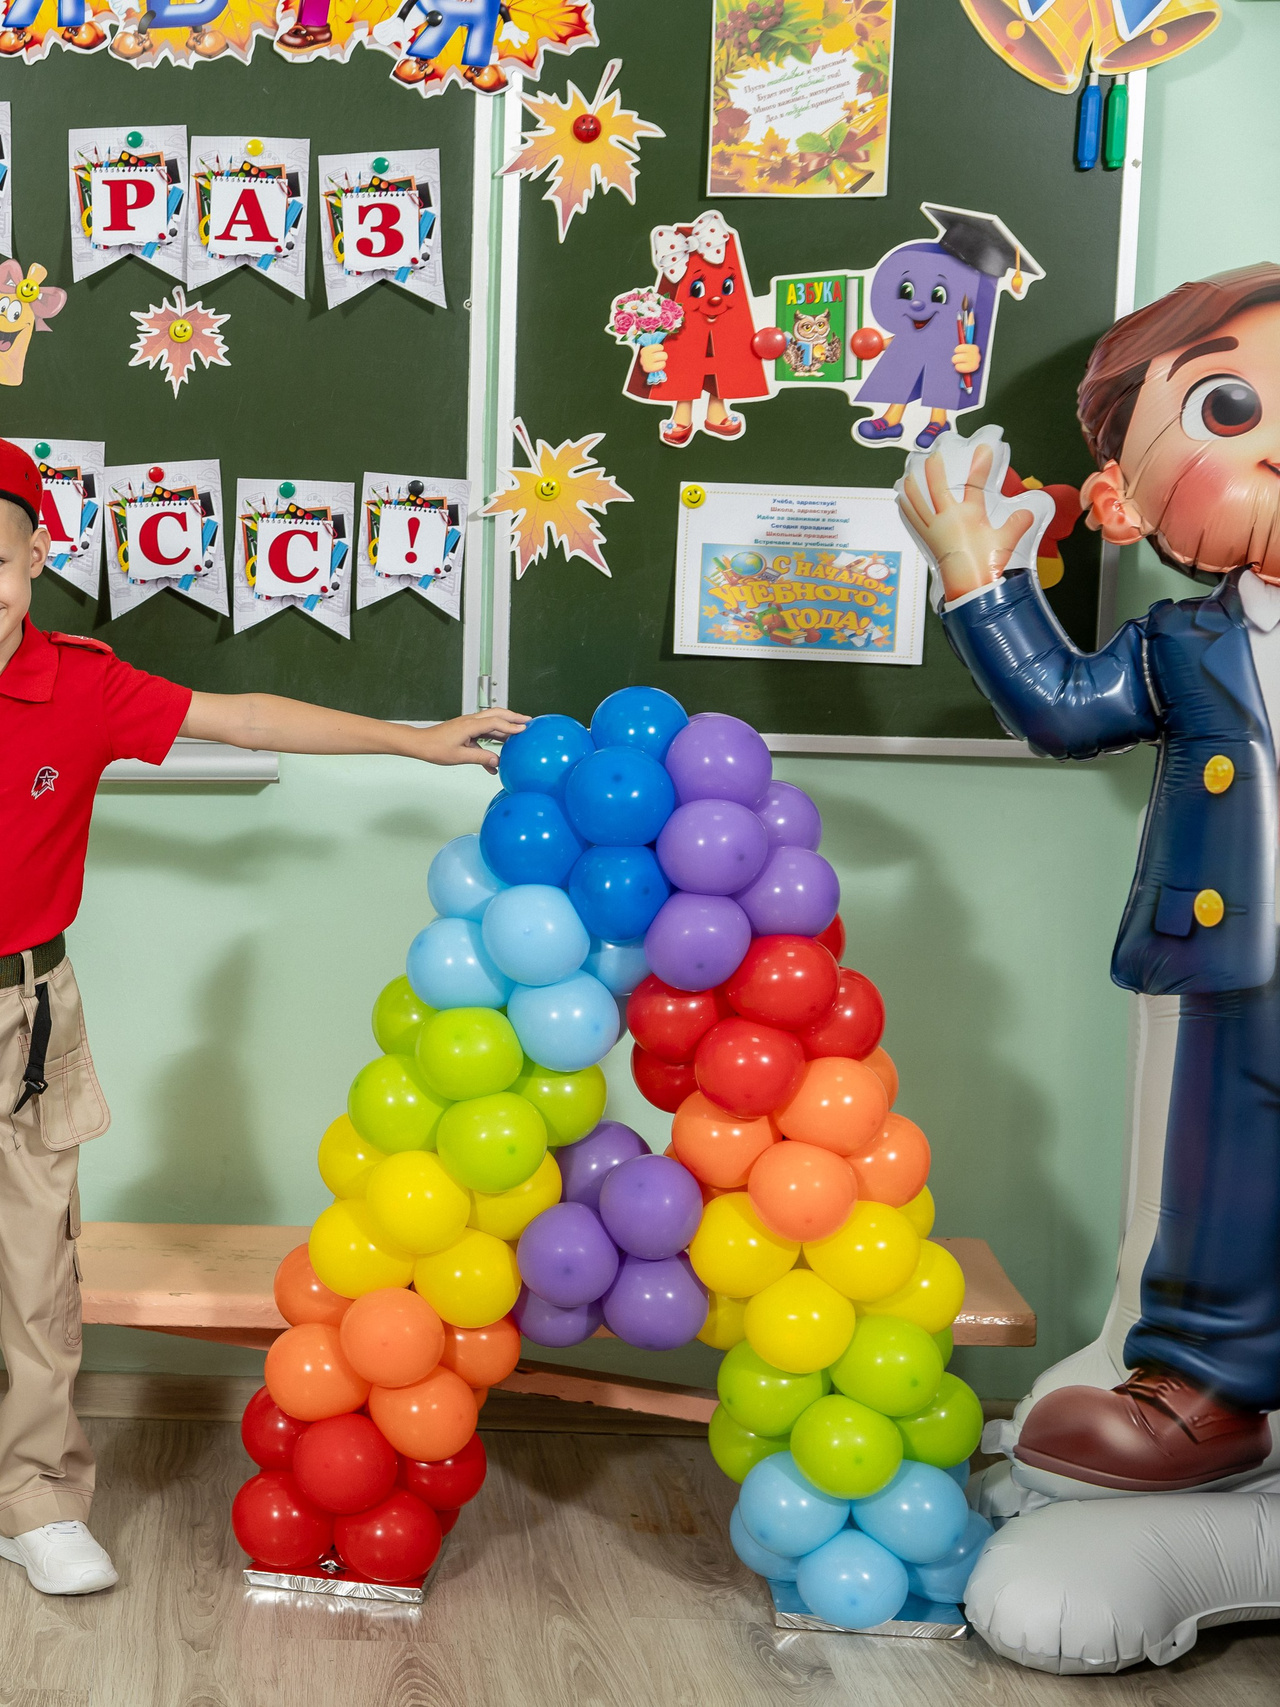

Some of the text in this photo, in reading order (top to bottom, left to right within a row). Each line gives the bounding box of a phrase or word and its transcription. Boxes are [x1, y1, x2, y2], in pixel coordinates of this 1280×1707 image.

[102, 178, 405, 259] РАЗ
[786, 281, 842, 305] АЗБУКА
[772, 555, 897, 597] С НАЧАЛОМ
[707, 580, 879, 610] УЧЕБНОГО
[781, 607, 872, 637] ГОДА!
